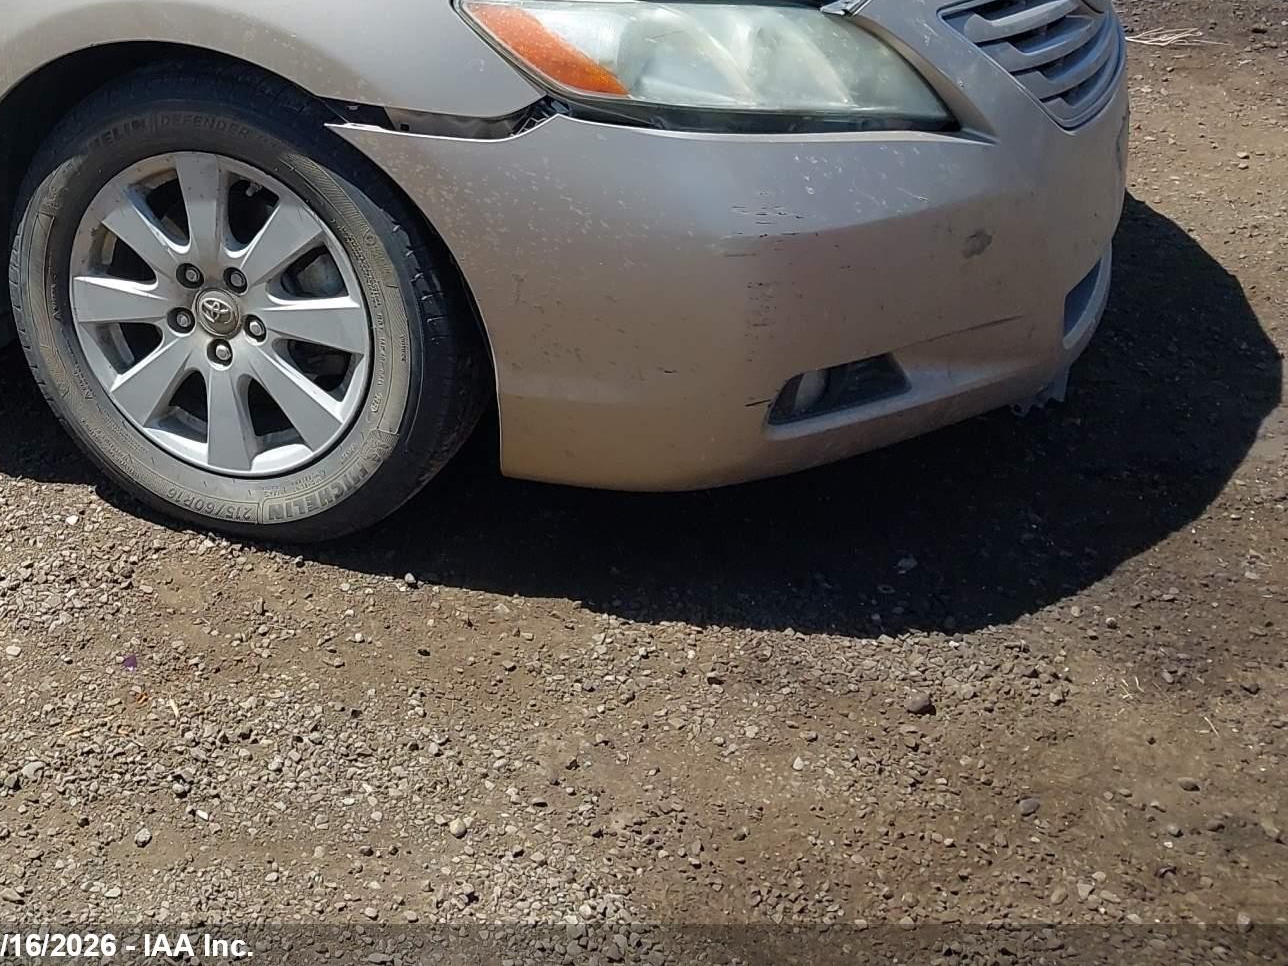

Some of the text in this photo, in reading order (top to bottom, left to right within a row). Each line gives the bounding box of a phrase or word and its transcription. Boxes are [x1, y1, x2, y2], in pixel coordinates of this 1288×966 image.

[161, 114, 249, 138] DEFENDER
[167, 488, 253, 521] 215/60R16
[268, 464, 371, 521] MICHELIN
